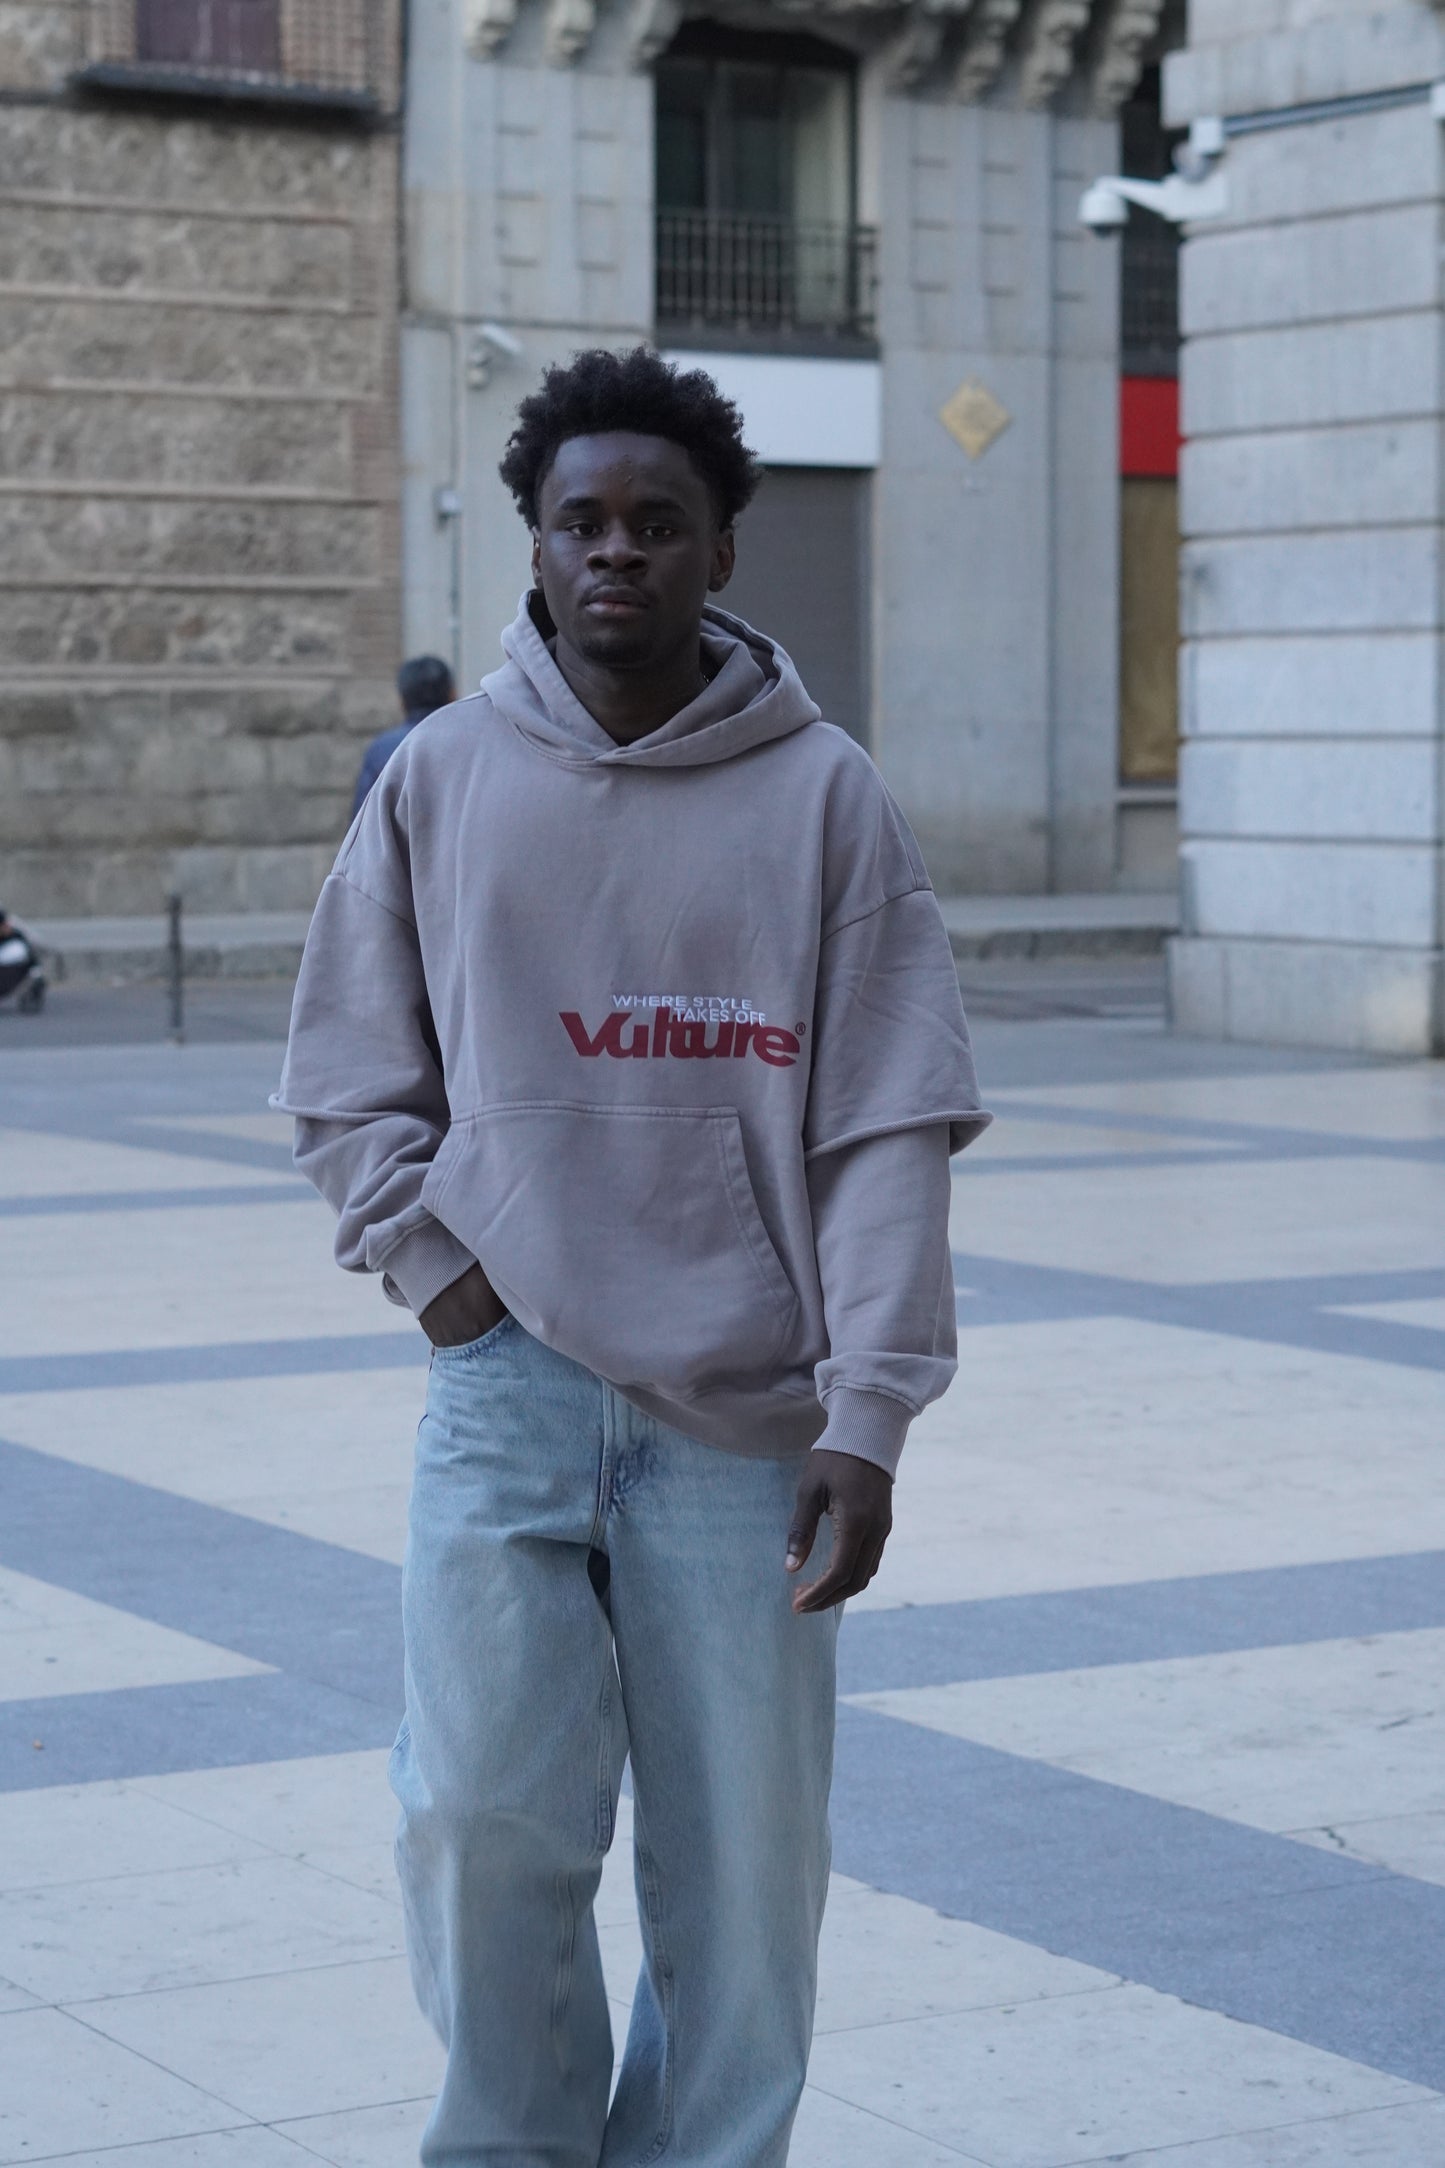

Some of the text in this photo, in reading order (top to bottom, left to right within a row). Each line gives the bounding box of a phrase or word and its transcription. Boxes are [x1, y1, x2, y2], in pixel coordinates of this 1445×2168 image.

[612, 995, 753, 1010] WHERE STYLE
[674, 1007, 766, 1026] TAKES OFF
